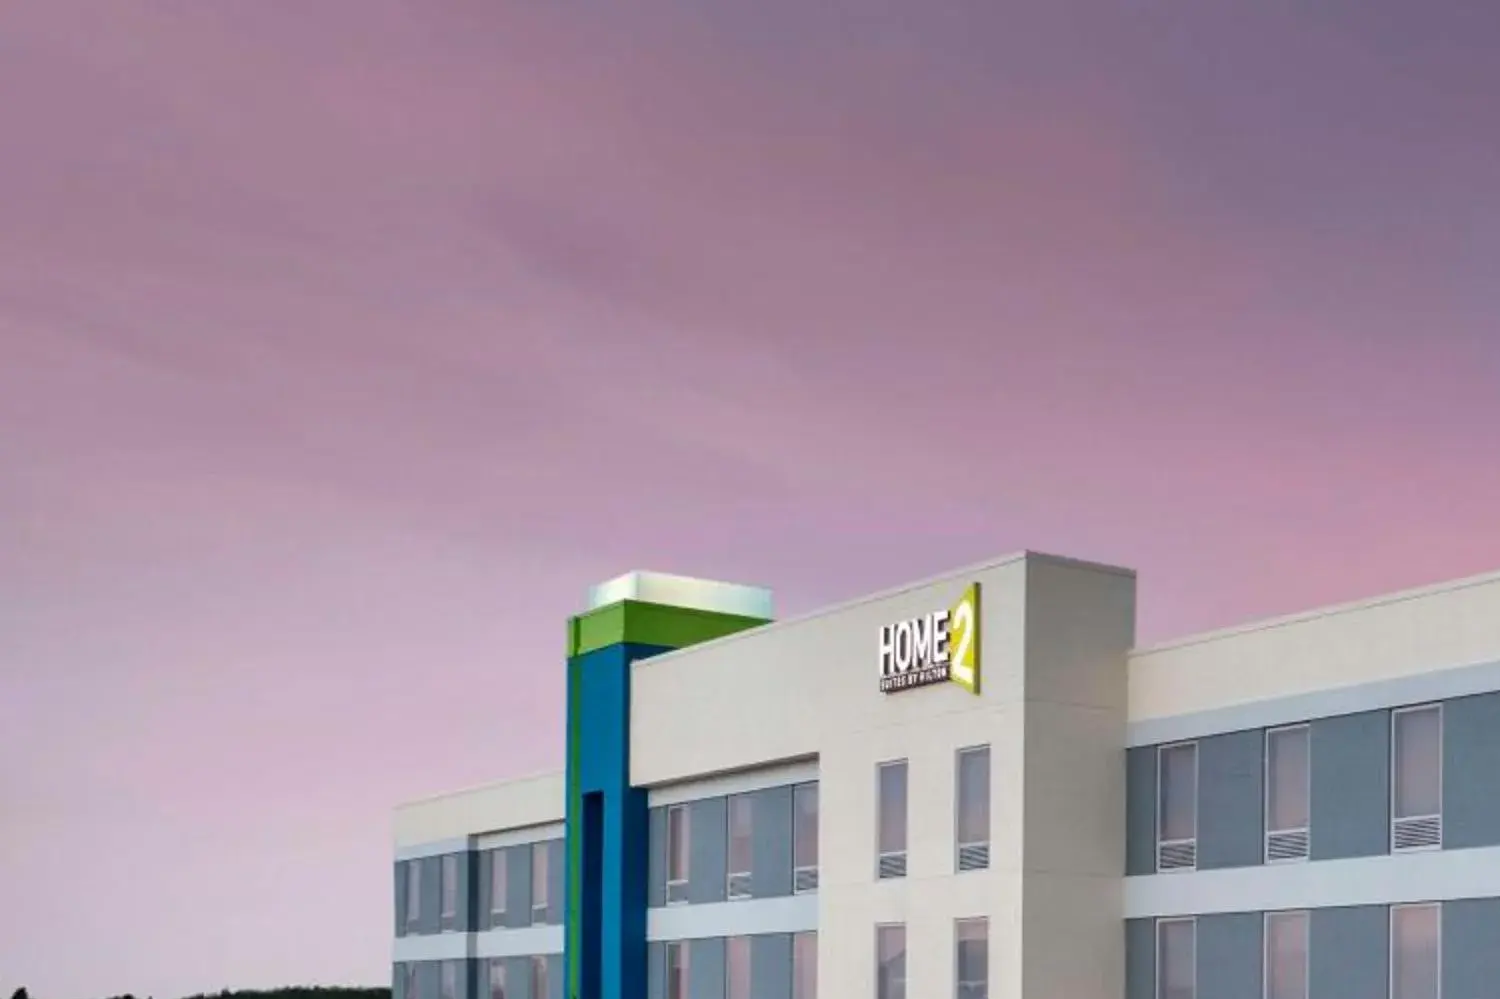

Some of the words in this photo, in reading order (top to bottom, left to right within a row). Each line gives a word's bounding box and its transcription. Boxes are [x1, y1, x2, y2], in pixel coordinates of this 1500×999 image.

[879, 610, 949, 677] HOME
[952, 599, 974, 684] 2
[880, 676, 906, 691] SUITES
[907, 674, 918, 685] BY
[919, 667, 947, 682] HILTON
